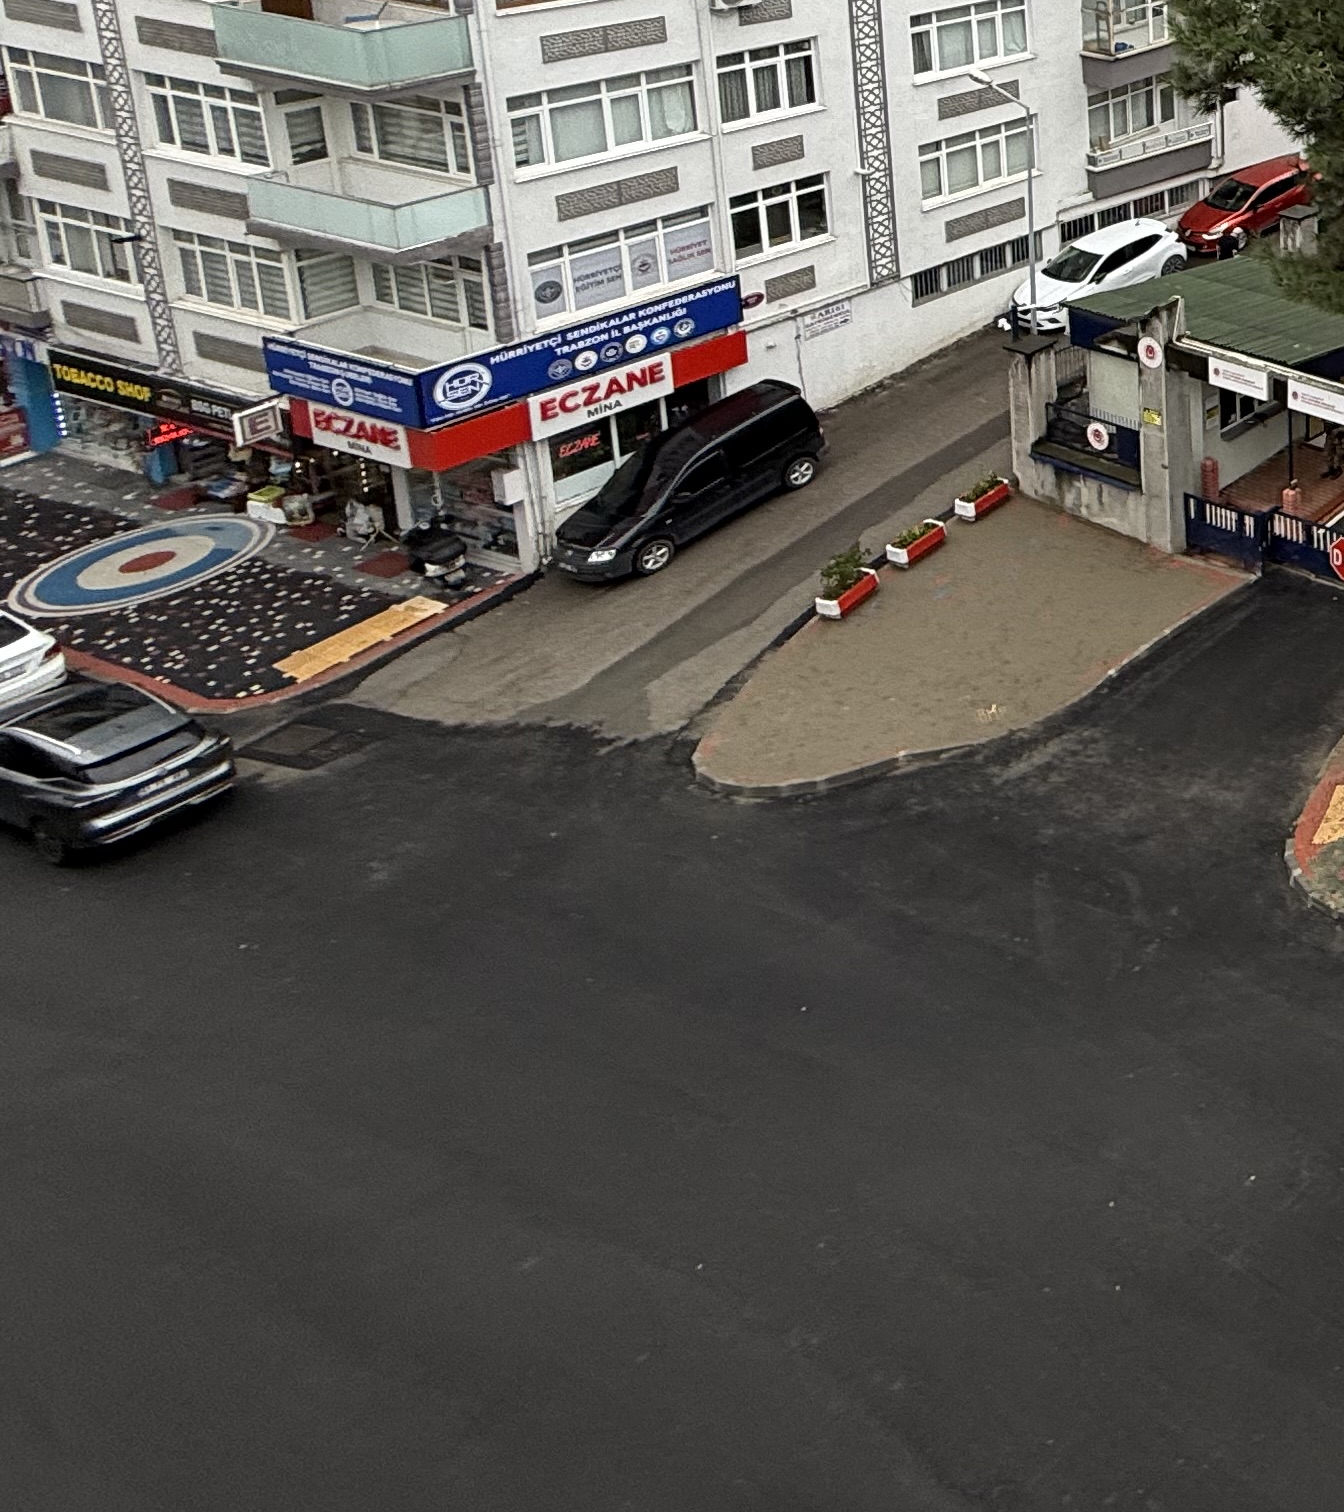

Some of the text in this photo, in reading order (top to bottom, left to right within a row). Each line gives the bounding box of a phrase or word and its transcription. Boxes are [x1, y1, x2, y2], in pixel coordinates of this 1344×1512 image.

[490, 334, 562, 365] HÜRRİYETÇİ
[566, 312, 636, 341] SENDİKALAR
[638, 280, 736, 317] KONFEDERASYONU
[554, 333, 609, 356] TRABZON
[623, 307, 687, 334] BAŞKANLIĞI
[53, 363, 114, 393] TOBACCO
[117, 379, 151, 401] SHOP
[540, 361, 666, 421] ECZANE
[313, 408, 401, 451] ECZANE
[587, 399, 623, 418] MİNA
